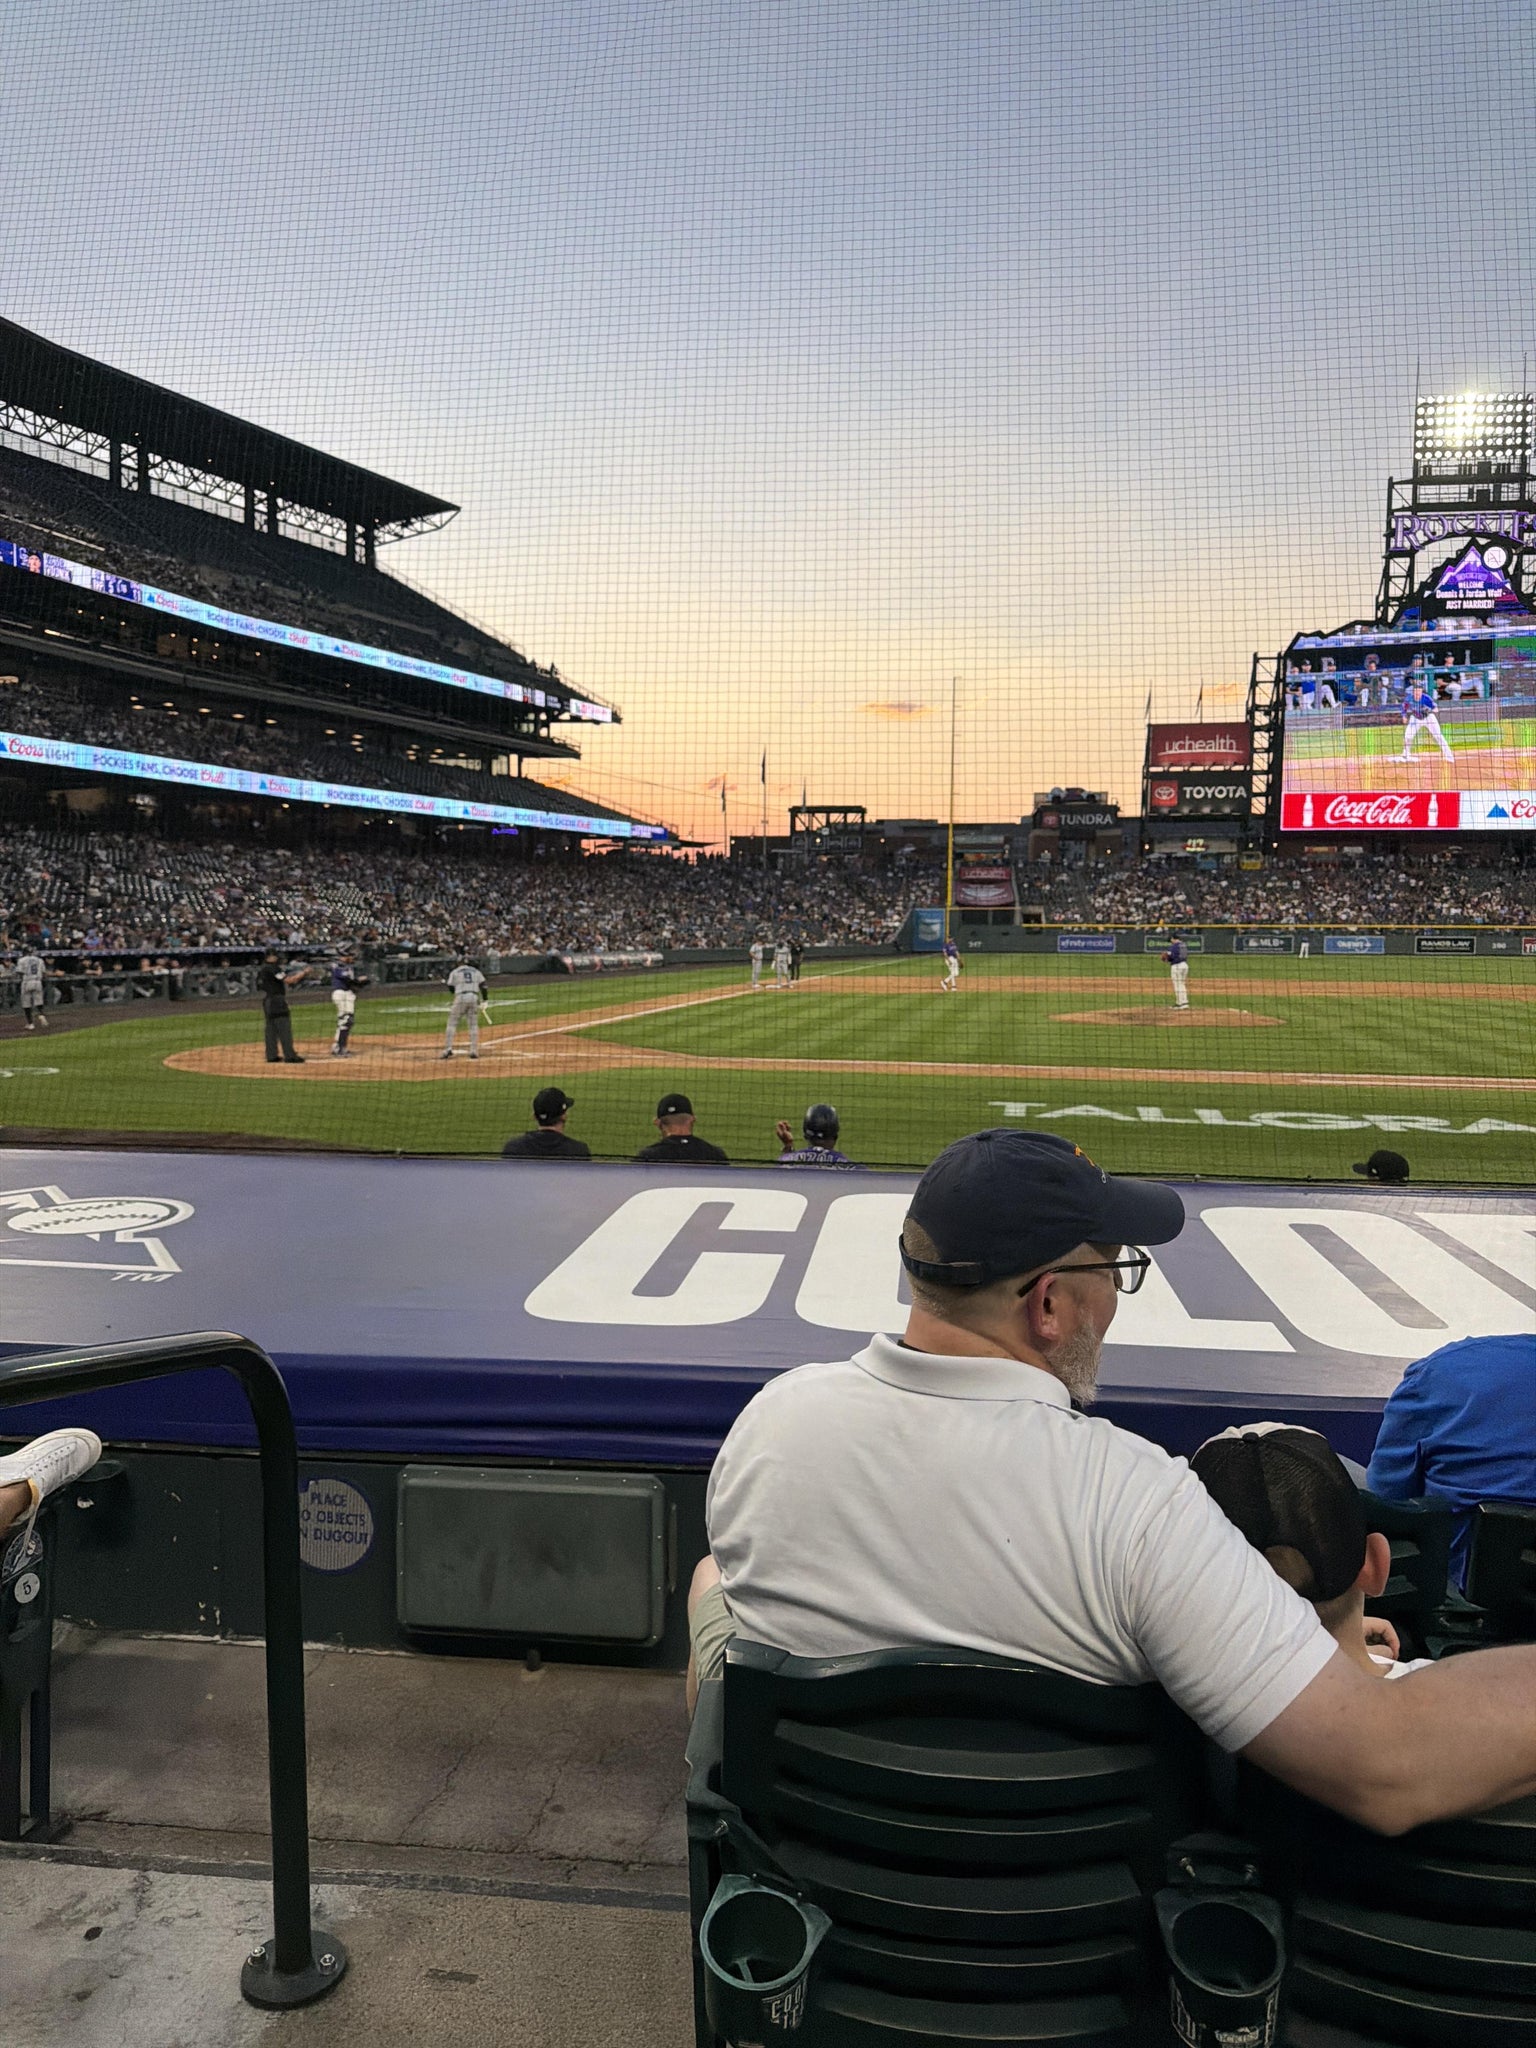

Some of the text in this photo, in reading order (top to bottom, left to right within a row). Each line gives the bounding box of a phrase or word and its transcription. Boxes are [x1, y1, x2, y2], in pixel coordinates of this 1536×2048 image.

[1389, 511, 1536, 550] ROCKIE
[1458, 581, 1484, 589] WELCOME
[1436, 589, 1457, 598] Dennis
[1466, 589, 1486, 598] Jordan
[1446, 600, 1461, 609] JUST
[1165, 734, 1236, 752] uchealth
[8, 737, 44, 757] Coors
[45, 749, 76, 762] LIGHT
[93, 754, 134, 770] ROCKIES
[162, 765, 198, 780] CHOOSE
[200, 769, 226, 784] Chill
[1182, 786, 1247, 799] TOYOTA
[1324, 795, 1416, 825] Coca-Cola
[1060, 814, 1113, 825] TUNDRA
[111, 1272, 174, 1283] TM
[300, 1509, 366, 1527] O OBJECTS
[313, 1528, 369, 1545] DUGOUT
[22, 1580, 32, 1596] 5
